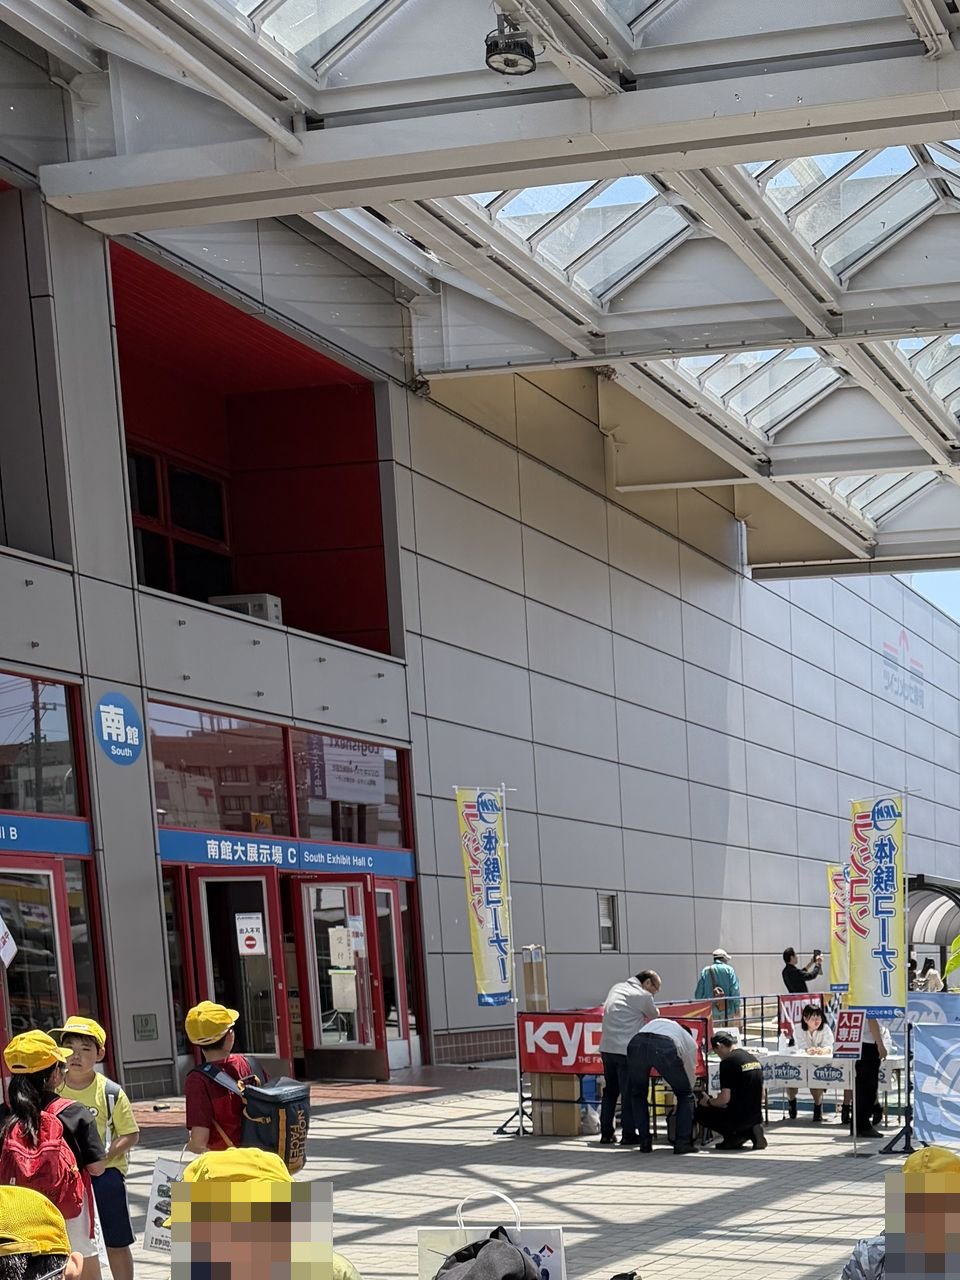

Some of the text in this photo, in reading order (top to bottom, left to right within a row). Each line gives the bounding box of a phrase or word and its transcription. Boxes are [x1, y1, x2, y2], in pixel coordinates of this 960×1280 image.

[100, 704, 139, 745] 南館
[111, 745, 132, 757] South
[9, 826, 18, 840] B
[206, 839, 297, 865] 南館大展示場 C
[304, 851, 374, 868] South Exhibit Hall C
[840, 1014, 862, 1026] 入口
[838, 1028, 860, 1042] 専用
[290, 1125, 299, 1157] FACE
